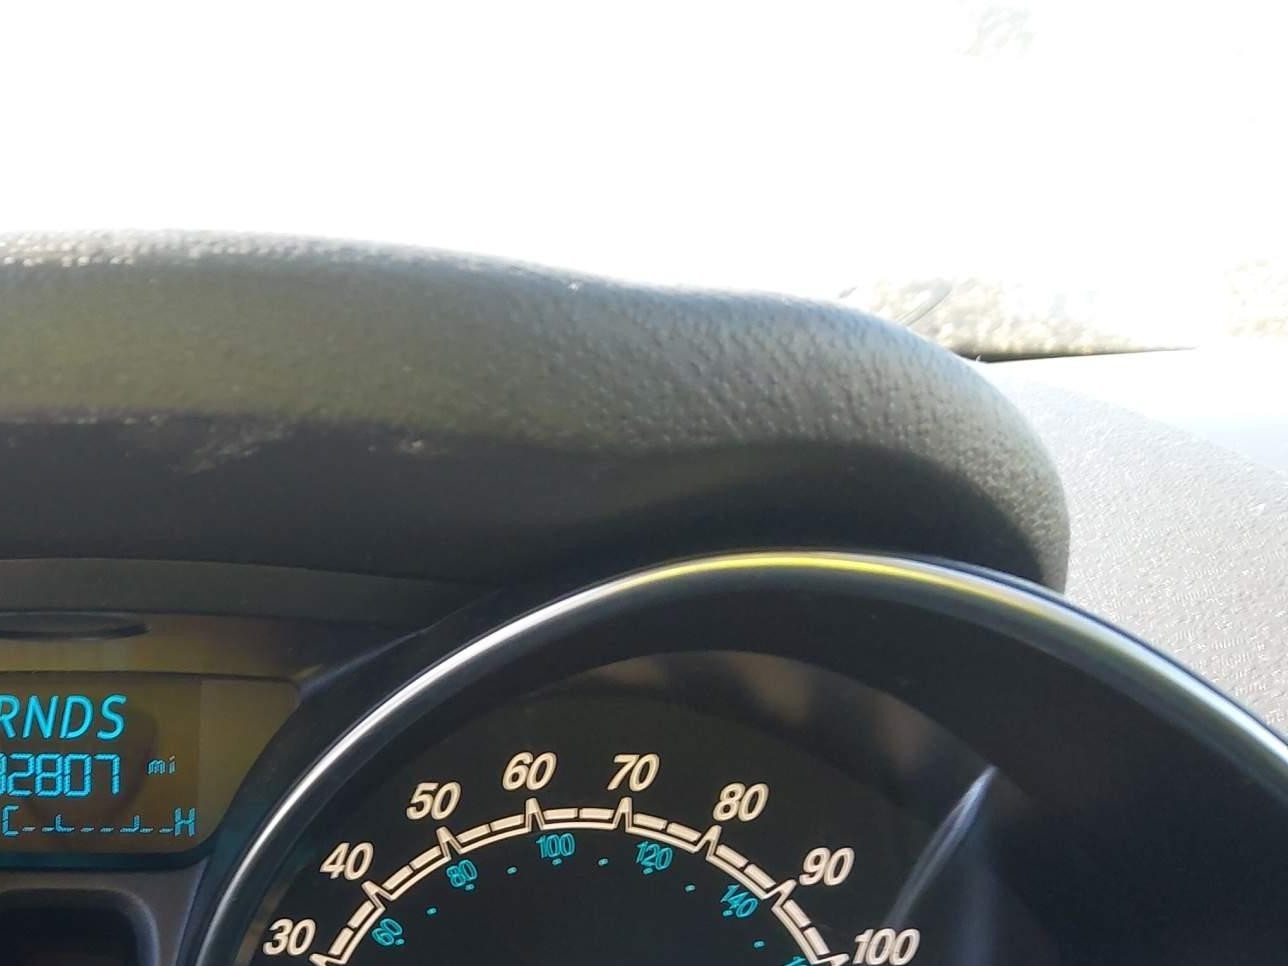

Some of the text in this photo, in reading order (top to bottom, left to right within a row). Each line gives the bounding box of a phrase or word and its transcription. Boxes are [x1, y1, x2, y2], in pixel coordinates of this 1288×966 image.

[147, 756, 177, 775] mi
[502, 752, 557, 791] 60
[607, 753, 660, 792] 70
[406, 782, 461, 820] 50
[712, 783, 769, 824] 80
[175, 808, 197, 837] H
[319, 842, 374, 882] 40
[536, 832, 575, 860] 100
[636, 843, 673, 872] 120
[446, 860, 478, 888] 80
[797, 847, 855, 888] 90
[722, 884, 758, 918] 140
[263, 918, 316, 958] 30
[371, 918, 404, 946] 60
[852, 928, 921, 966] 100
